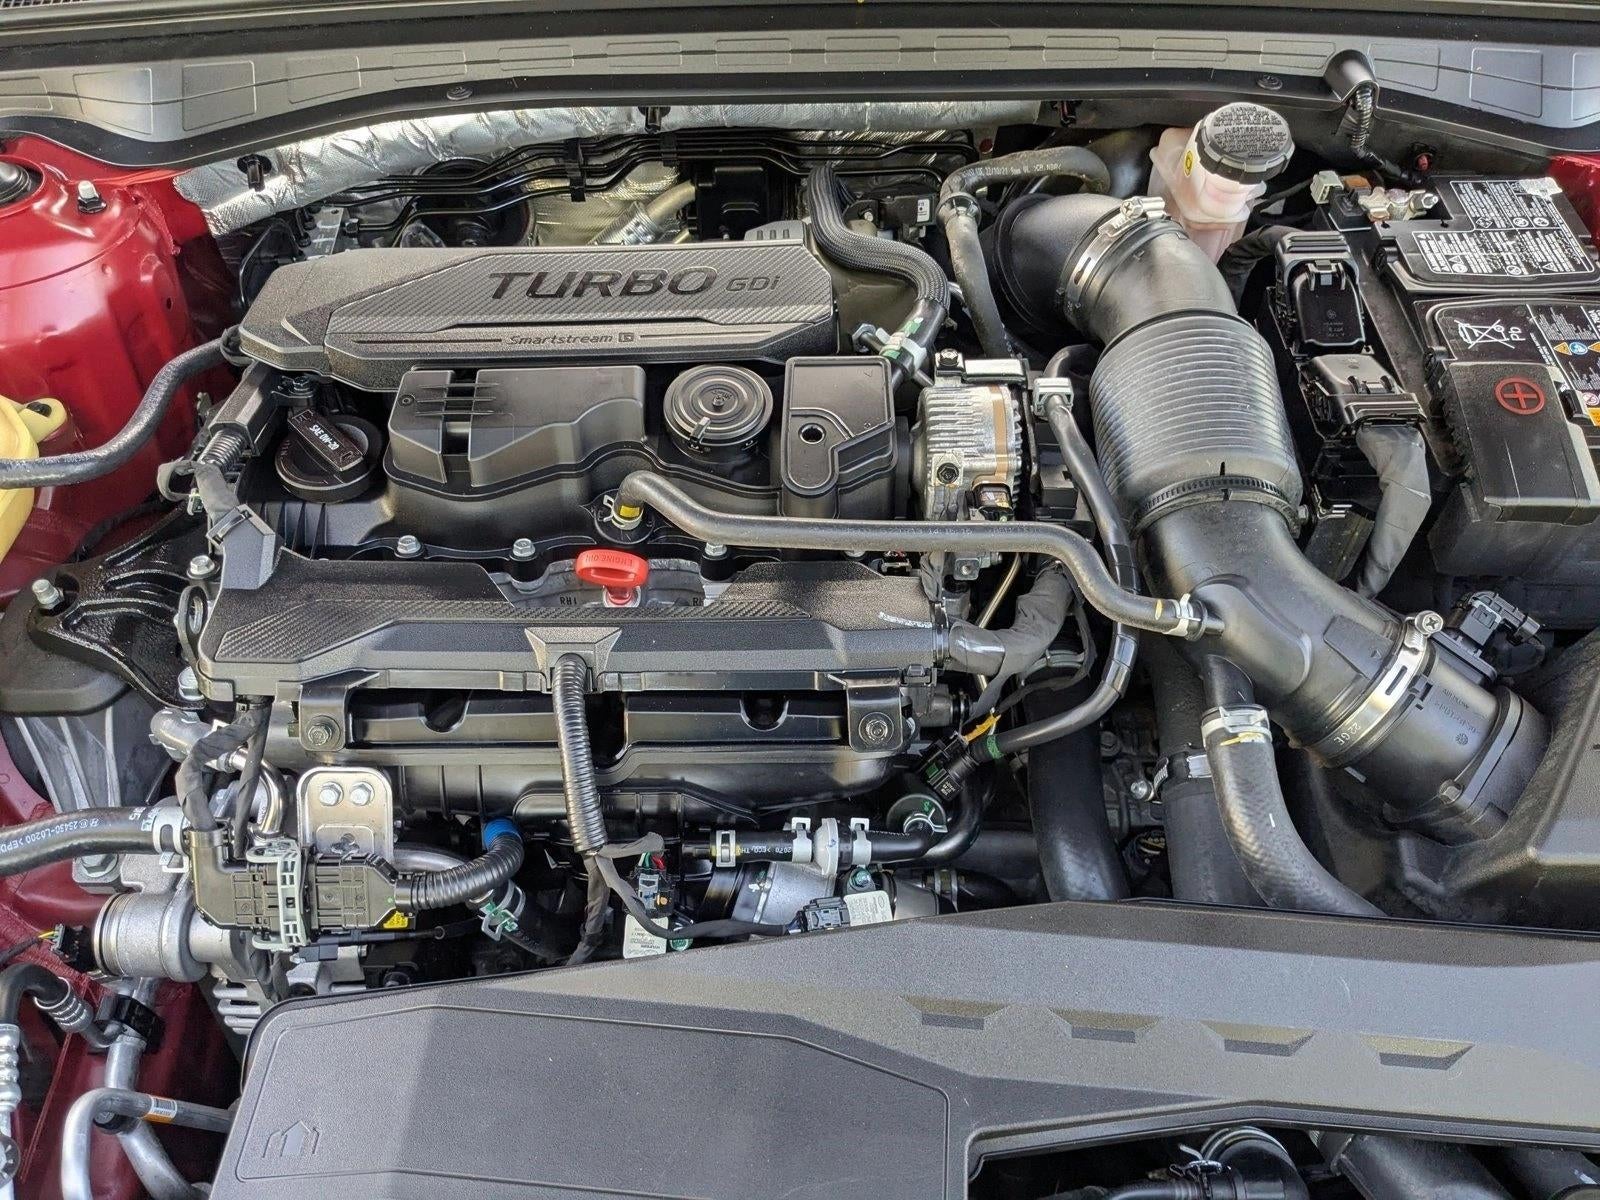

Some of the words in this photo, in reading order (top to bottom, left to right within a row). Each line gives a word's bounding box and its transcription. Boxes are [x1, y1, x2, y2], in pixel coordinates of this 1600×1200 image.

[488, 266, 718, 299] TURBO
[725, 275, 781, 292] GDi
[507, 333, 613, 345] Smartstream
[1508, 326, 1526, 341] Pb
[308, 423, 325, 437] SAE
[318, 432, 340, 451] 0W-20
[1347, 722, 1362, 735] 22
[1333, 732, 1351, 746] GE
